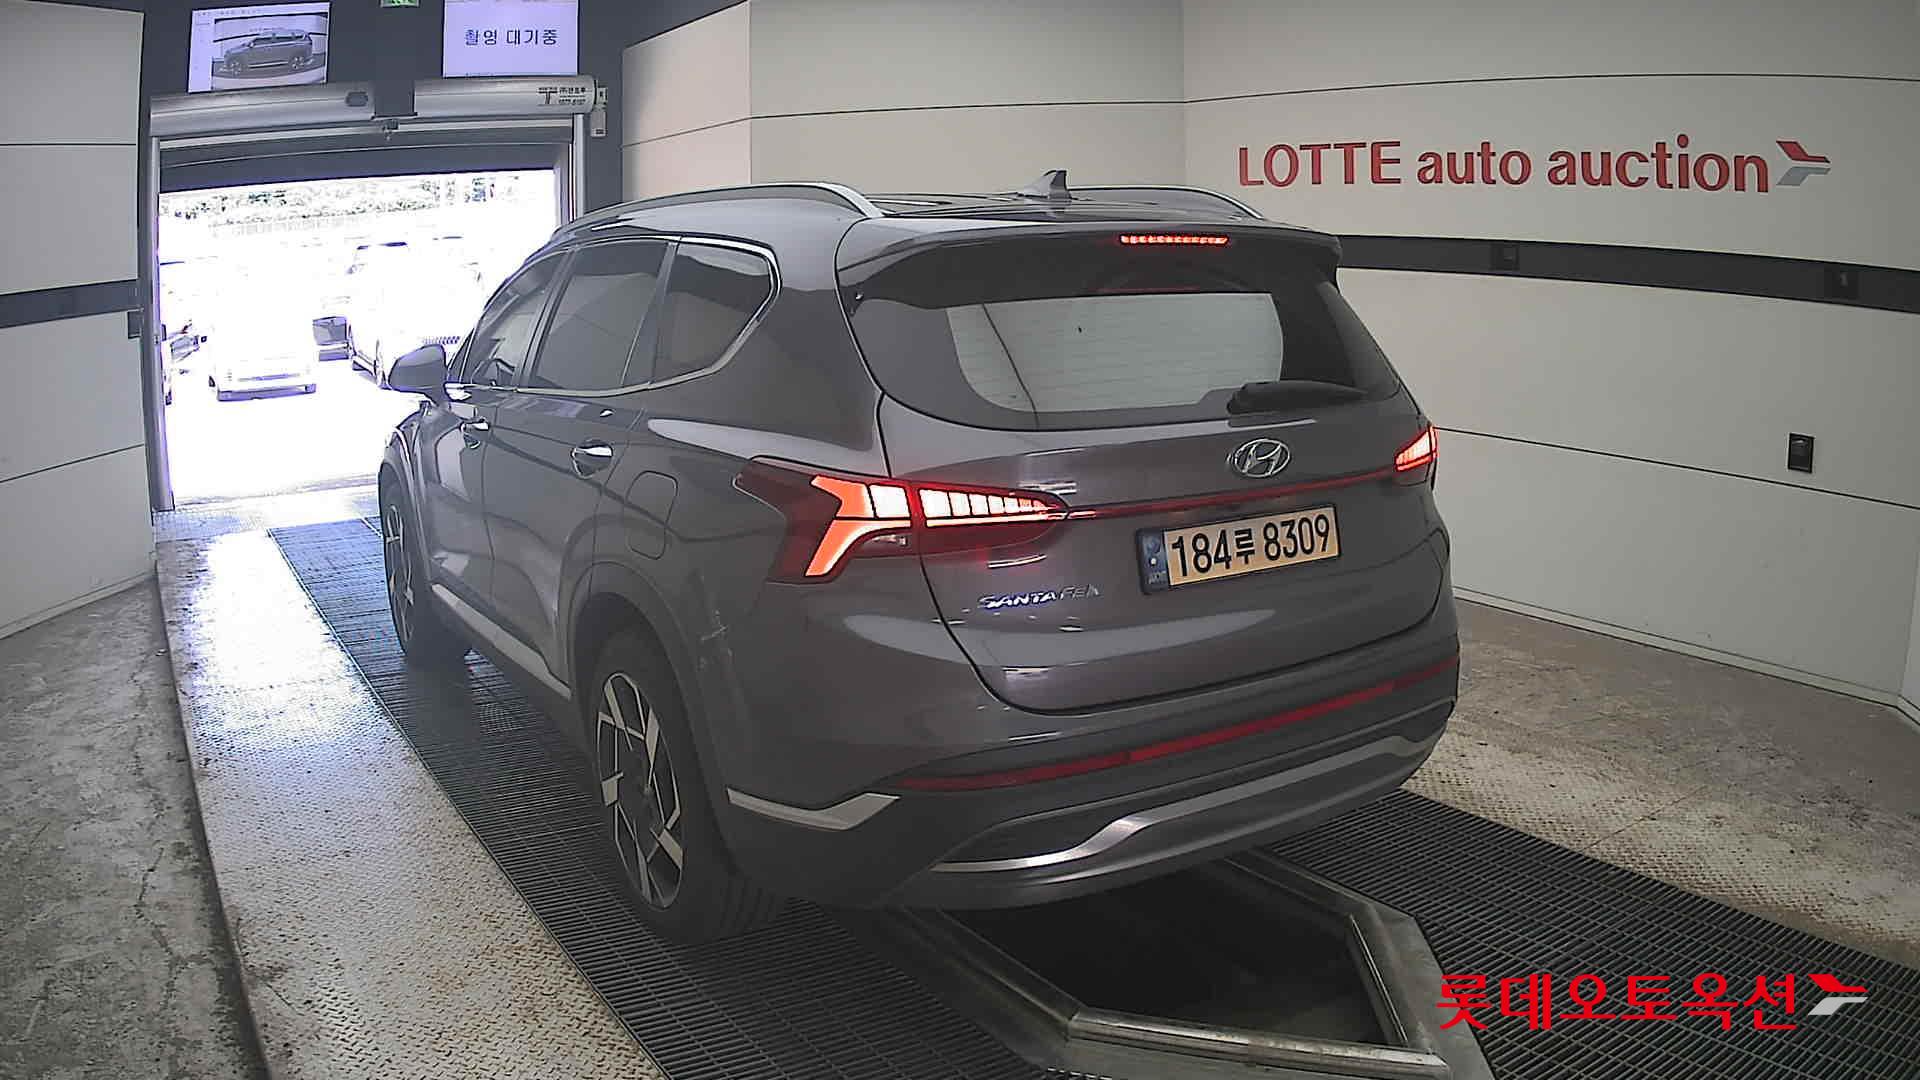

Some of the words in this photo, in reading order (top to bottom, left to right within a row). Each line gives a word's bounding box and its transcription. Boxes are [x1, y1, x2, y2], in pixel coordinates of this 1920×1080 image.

[505, 28, 558, 46] 대기중
[1239, 141, 1401, 187] LOTTE
[1416, 140, 1532, 185] auto
[1547, 133, 1770, 193] auction
[1171, 528, 1256, 577] 184루
[1262, 513, 1331, 561] 8309
[978, 591, 1057, 608] SANTA
